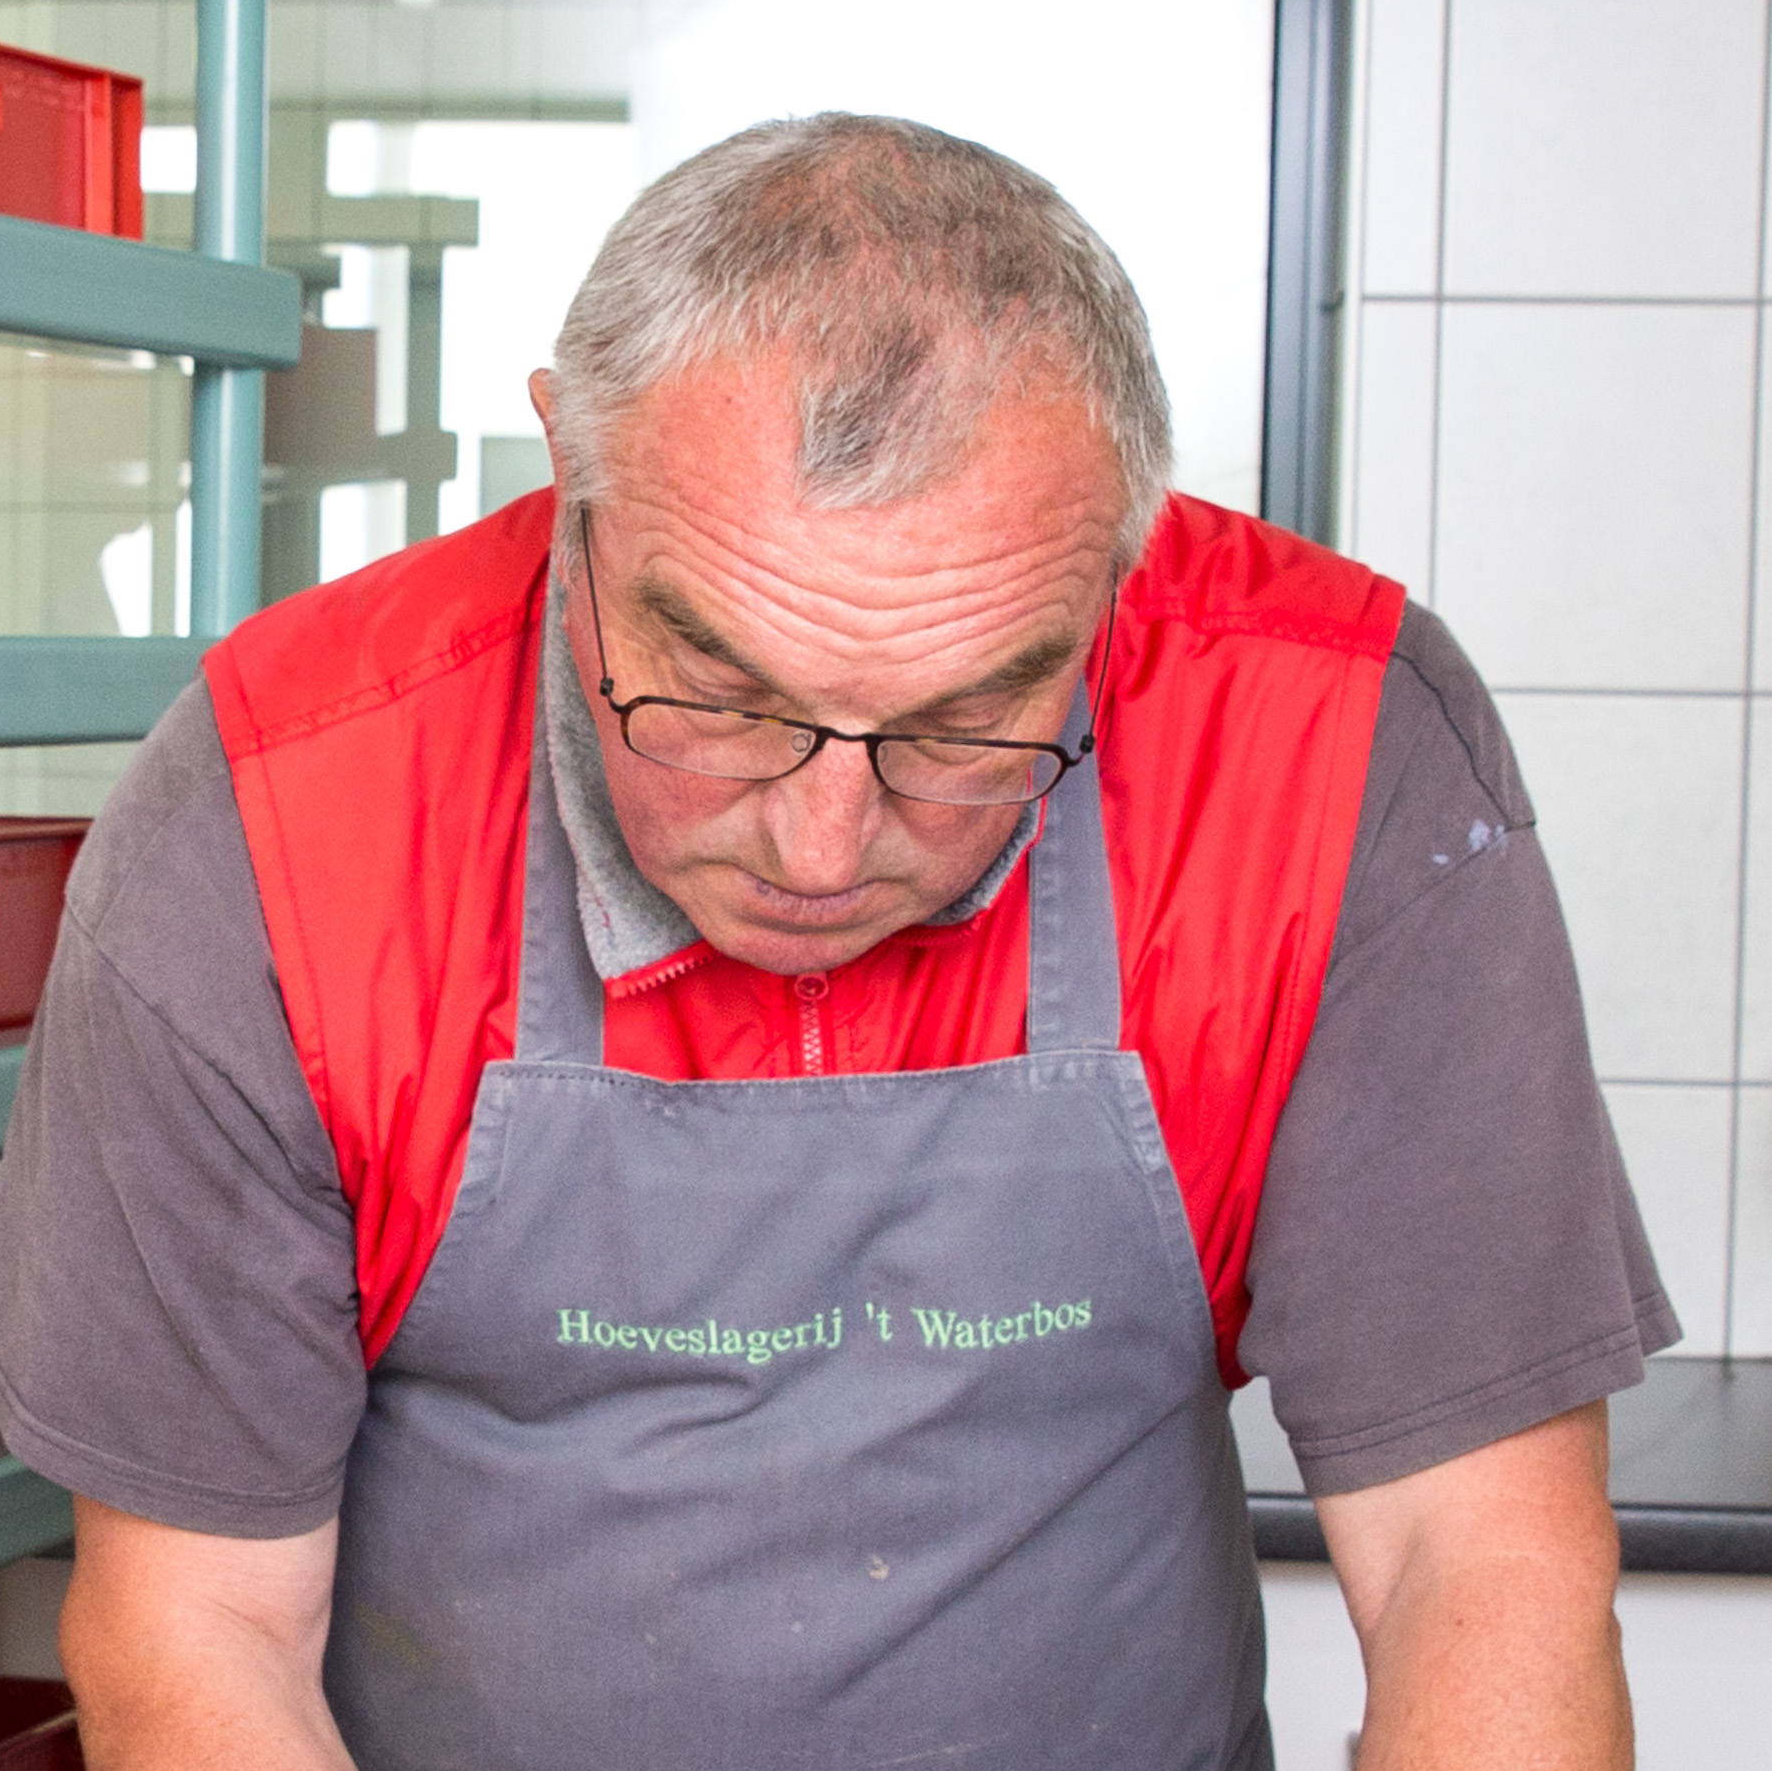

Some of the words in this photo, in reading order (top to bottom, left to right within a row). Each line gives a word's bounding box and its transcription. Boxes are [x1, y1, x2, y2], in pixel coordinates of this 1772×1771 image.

[557, 1307, 842, 1364] Hoeveslagerij
[865, 1301, 893, 1342] 't
[912, 1298, 1094, 1349] Waterbos
